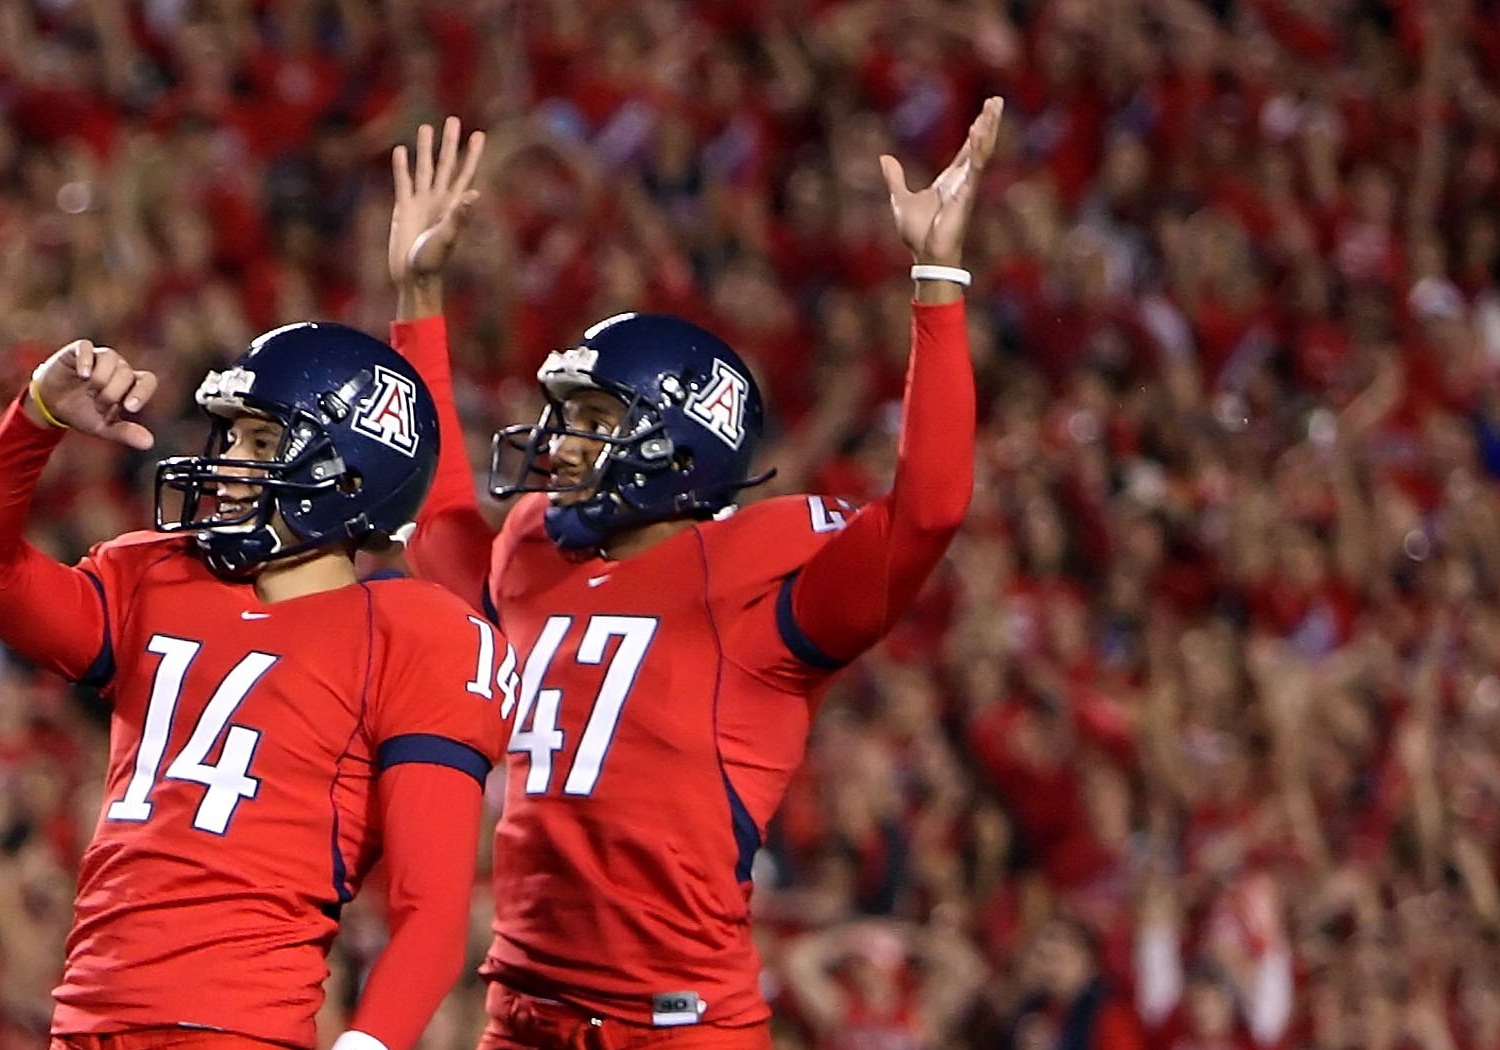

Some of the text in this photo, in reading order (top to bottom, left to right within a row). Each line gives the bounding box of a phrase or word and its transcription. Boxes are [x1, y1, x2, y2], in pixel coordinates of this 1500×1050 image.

[350, 364, 420, 459] A
[683, 357, 750, 451] A
[106, 634, 281, 837] 14
[506, 614, 660, 796] 47
